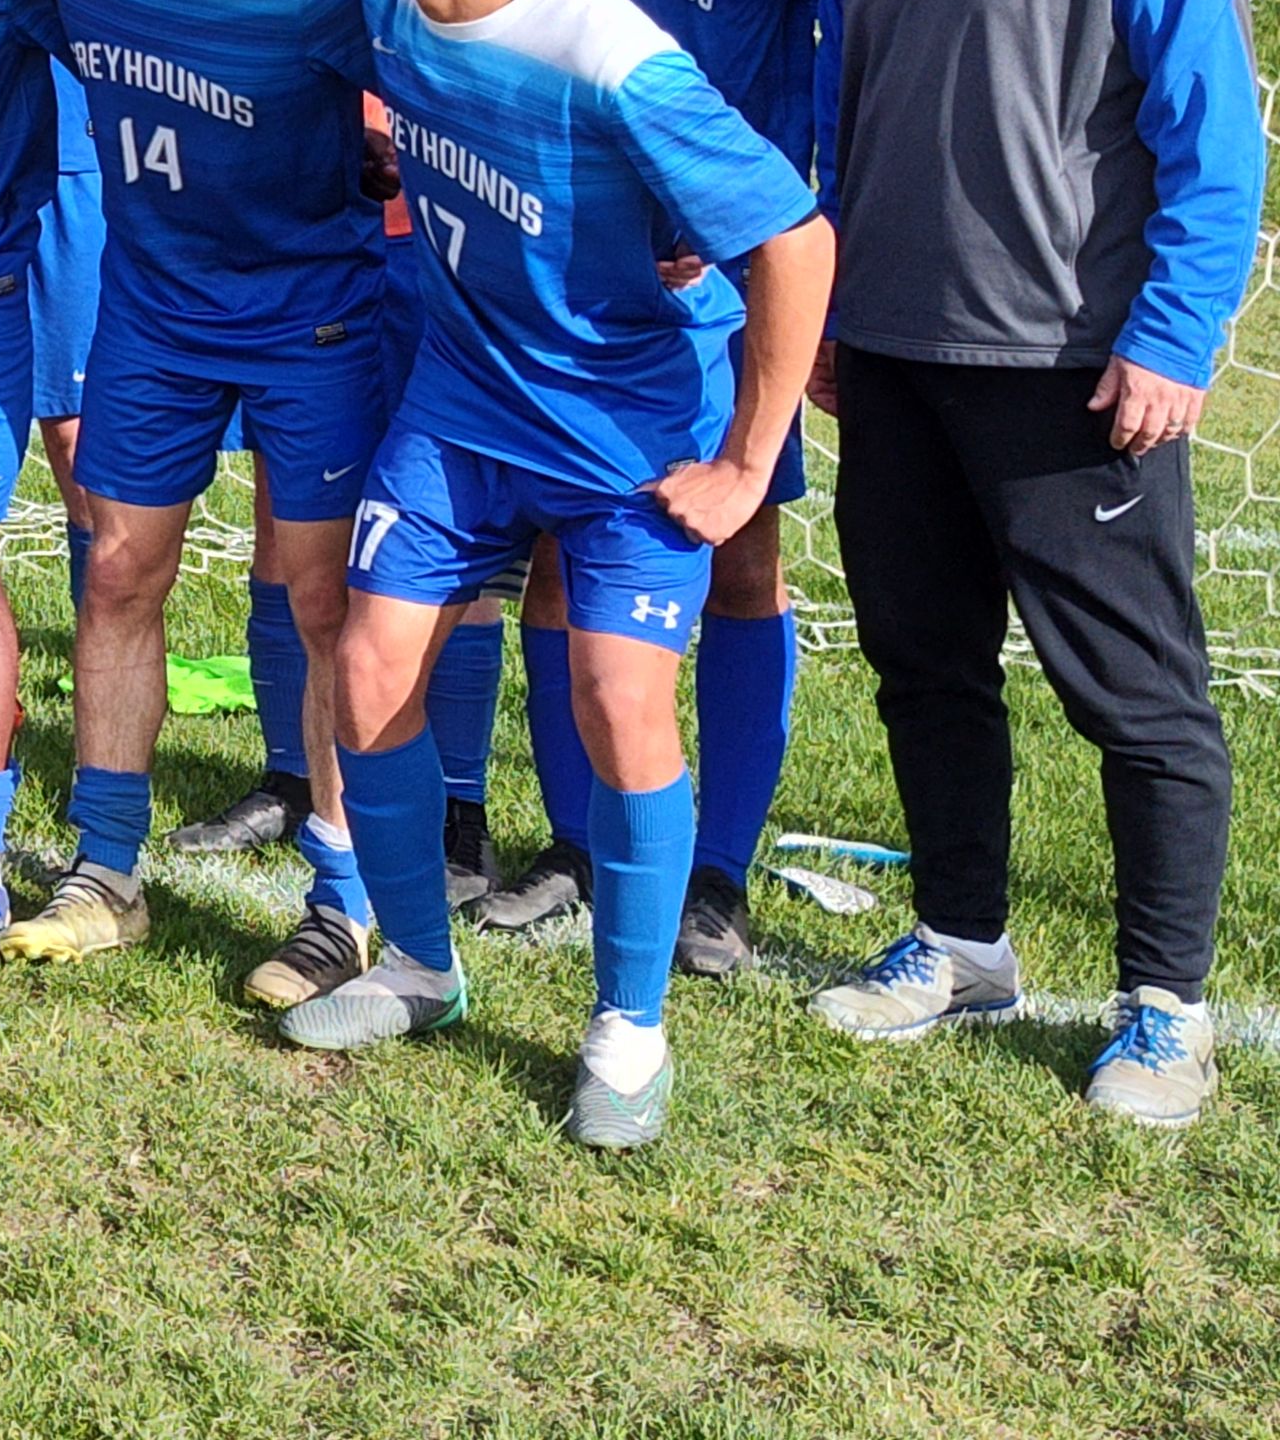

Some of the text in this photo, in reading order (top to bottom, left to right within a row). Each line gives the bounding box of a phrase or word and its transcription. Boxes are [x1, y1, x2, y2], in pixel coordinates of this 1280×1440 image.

[119, 117, 183, 192] 14
[417, 194, 467, 279] 17
[347, 498, 400, 572] 17
